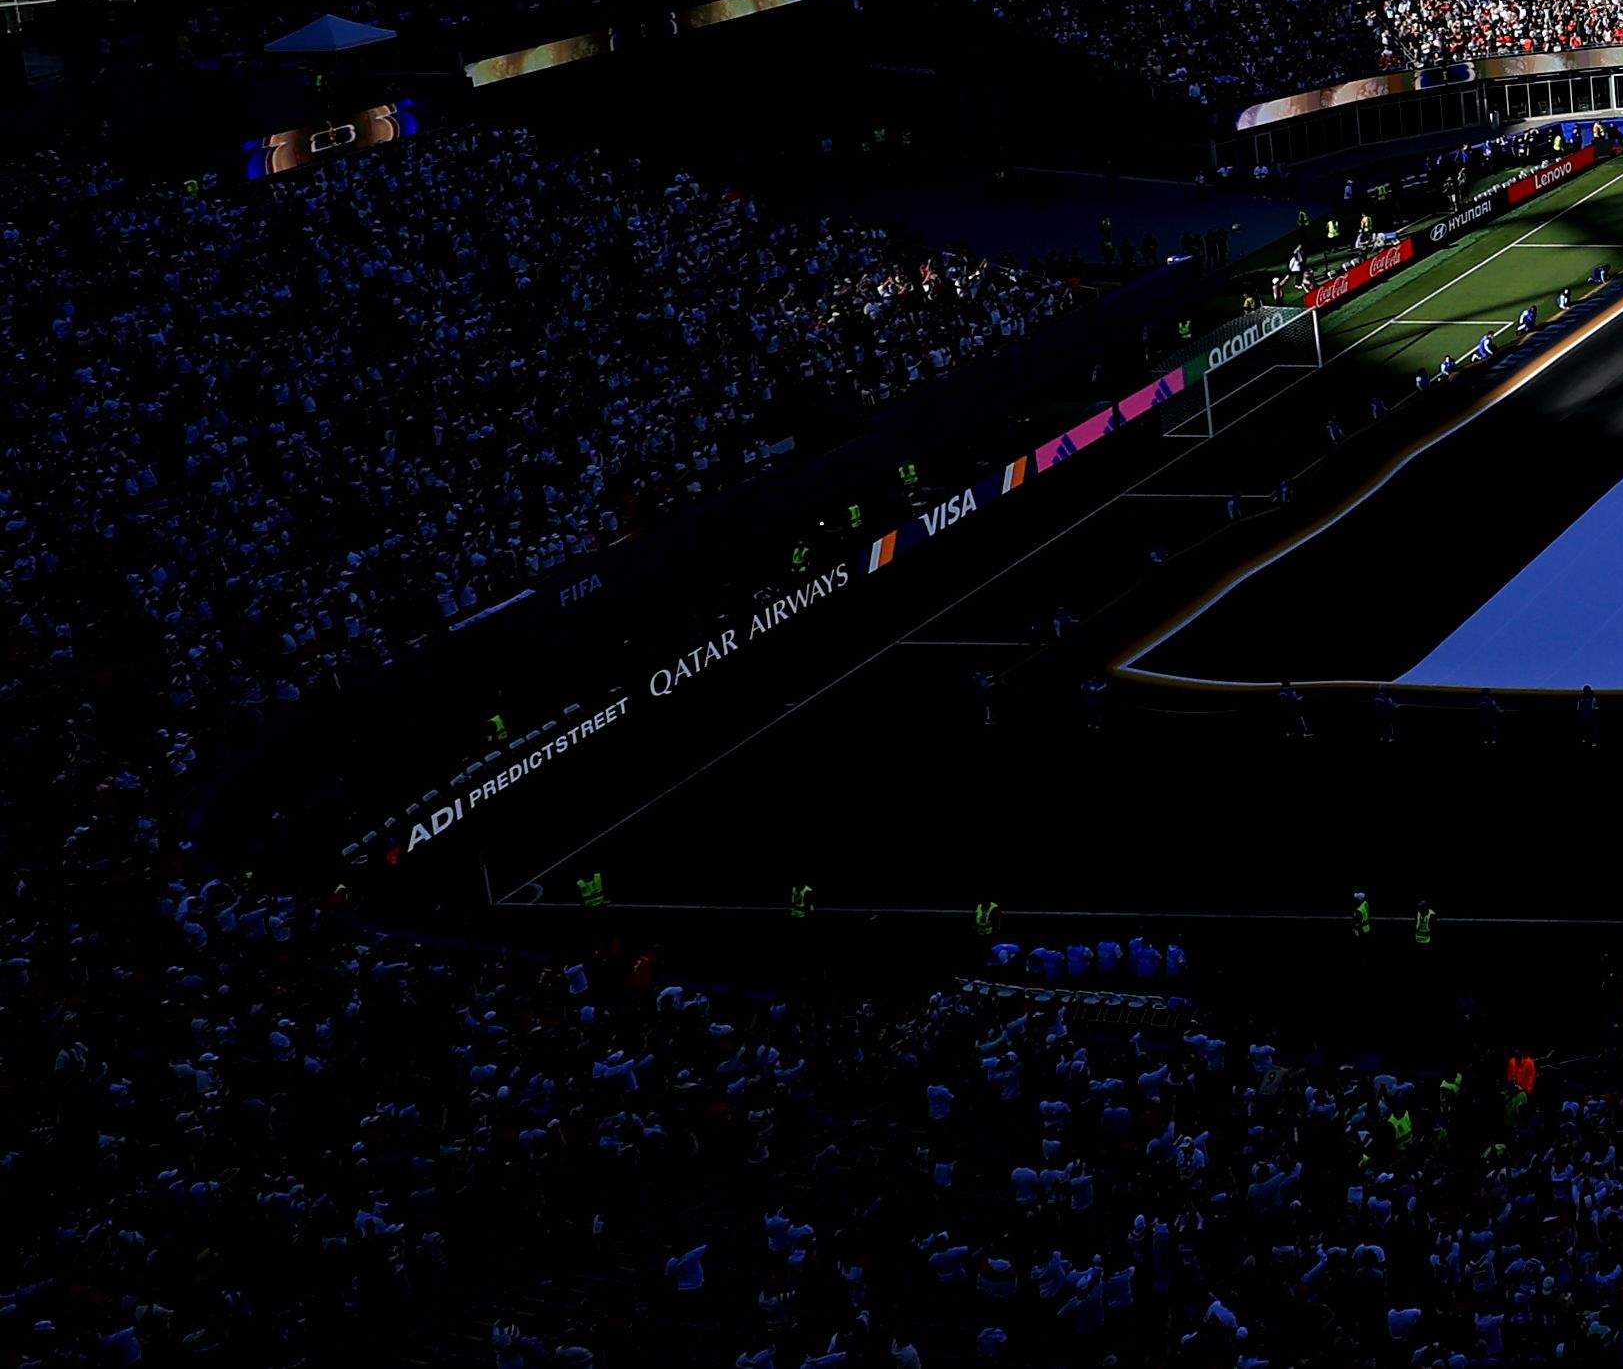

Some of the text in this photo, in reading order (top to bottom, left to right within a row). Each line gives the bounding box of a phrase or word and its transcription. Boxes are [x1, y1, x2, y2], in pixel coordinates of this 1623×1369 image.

[1534, 161, 1572, 190] Lenovo
[1448, 200, 1492, 232] HYUNDAI
[1208, 313, 1284, 368] aramco
[916, 488, 978, 537] VISA
[560, 573, 603, 609] FIFA
[649, 563, 849, 697] QATAR AIRWAYS
[407, 696, 629, 853] ADI PREDICTSTREET
